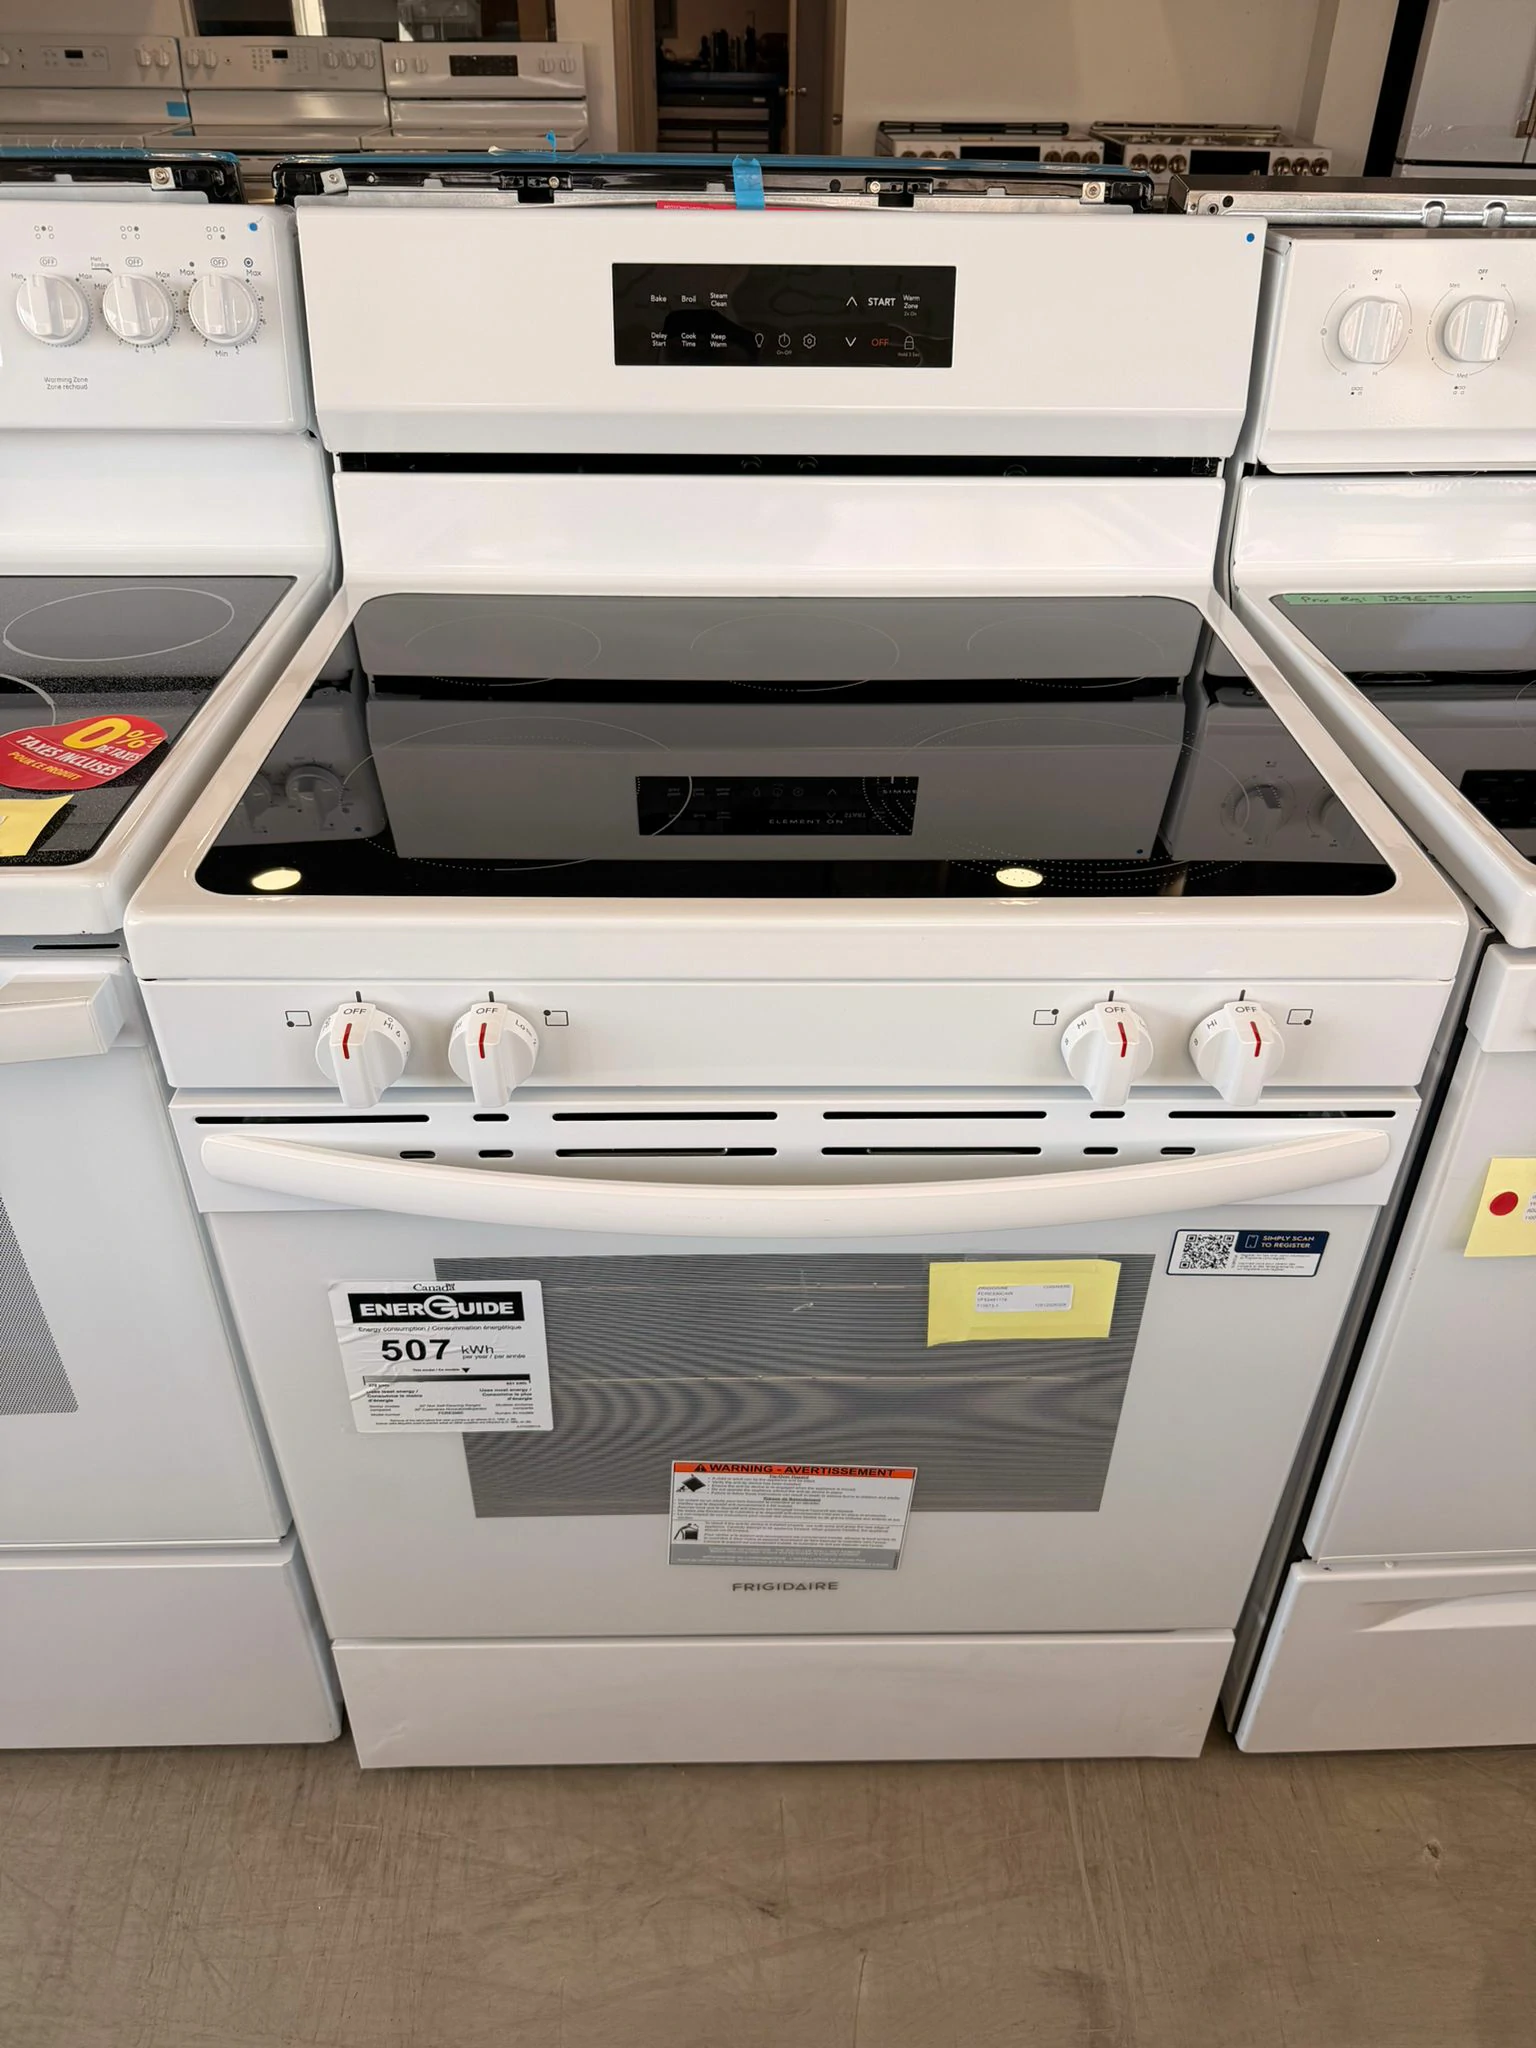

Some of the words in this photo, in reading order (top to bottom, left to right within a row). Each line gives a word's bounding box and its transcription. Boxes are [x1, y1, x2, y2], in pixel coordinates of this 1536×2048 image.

[650, 295, 667, 303] Bake
[681, 295, 697, 303] Broil
[867, 297, 896, 307] START
[903, 294, 921, 302] Warm
[650, 332, 668, 340] Delay
[681, 332, 697, 340] Cook
[711, 333, 727, 341] Keep
[871, 338, 890, 347] OFF
[15, 735, 63, 758] TAXES
[55, 751, 123, 776] INCLUSES
[8, 751, 35, 766] POUR
[31, 759, 47, 769] CE
[42, 764, 83, 781] PRODUIT
[343, 1007, 367, 1015] OFF
[476, 1007, 499, 1015] OFF
[1104, 1006, 1127, 1014] OFF
[382, 1020, 395, 1030] Hi
[515, 1019, 525, 1030] Lo
[1077, 1018, 1087, 1029] Hi
[1206, 1018, 1217, 1030] Hi
[413, 1283, 456, 1292] Canada
[359, 1294, 515, 1320] ENERGUIDE
[381, 1339, 450, 1361] 507
[461, 1345, 494, 1354] kWh
[709, 1463, 773, 1473] WARNING
[784, 1465, 896, 1477] AVERTISSEMENT
[732, 1581, 839, 1592] FRIGIDAIRE
